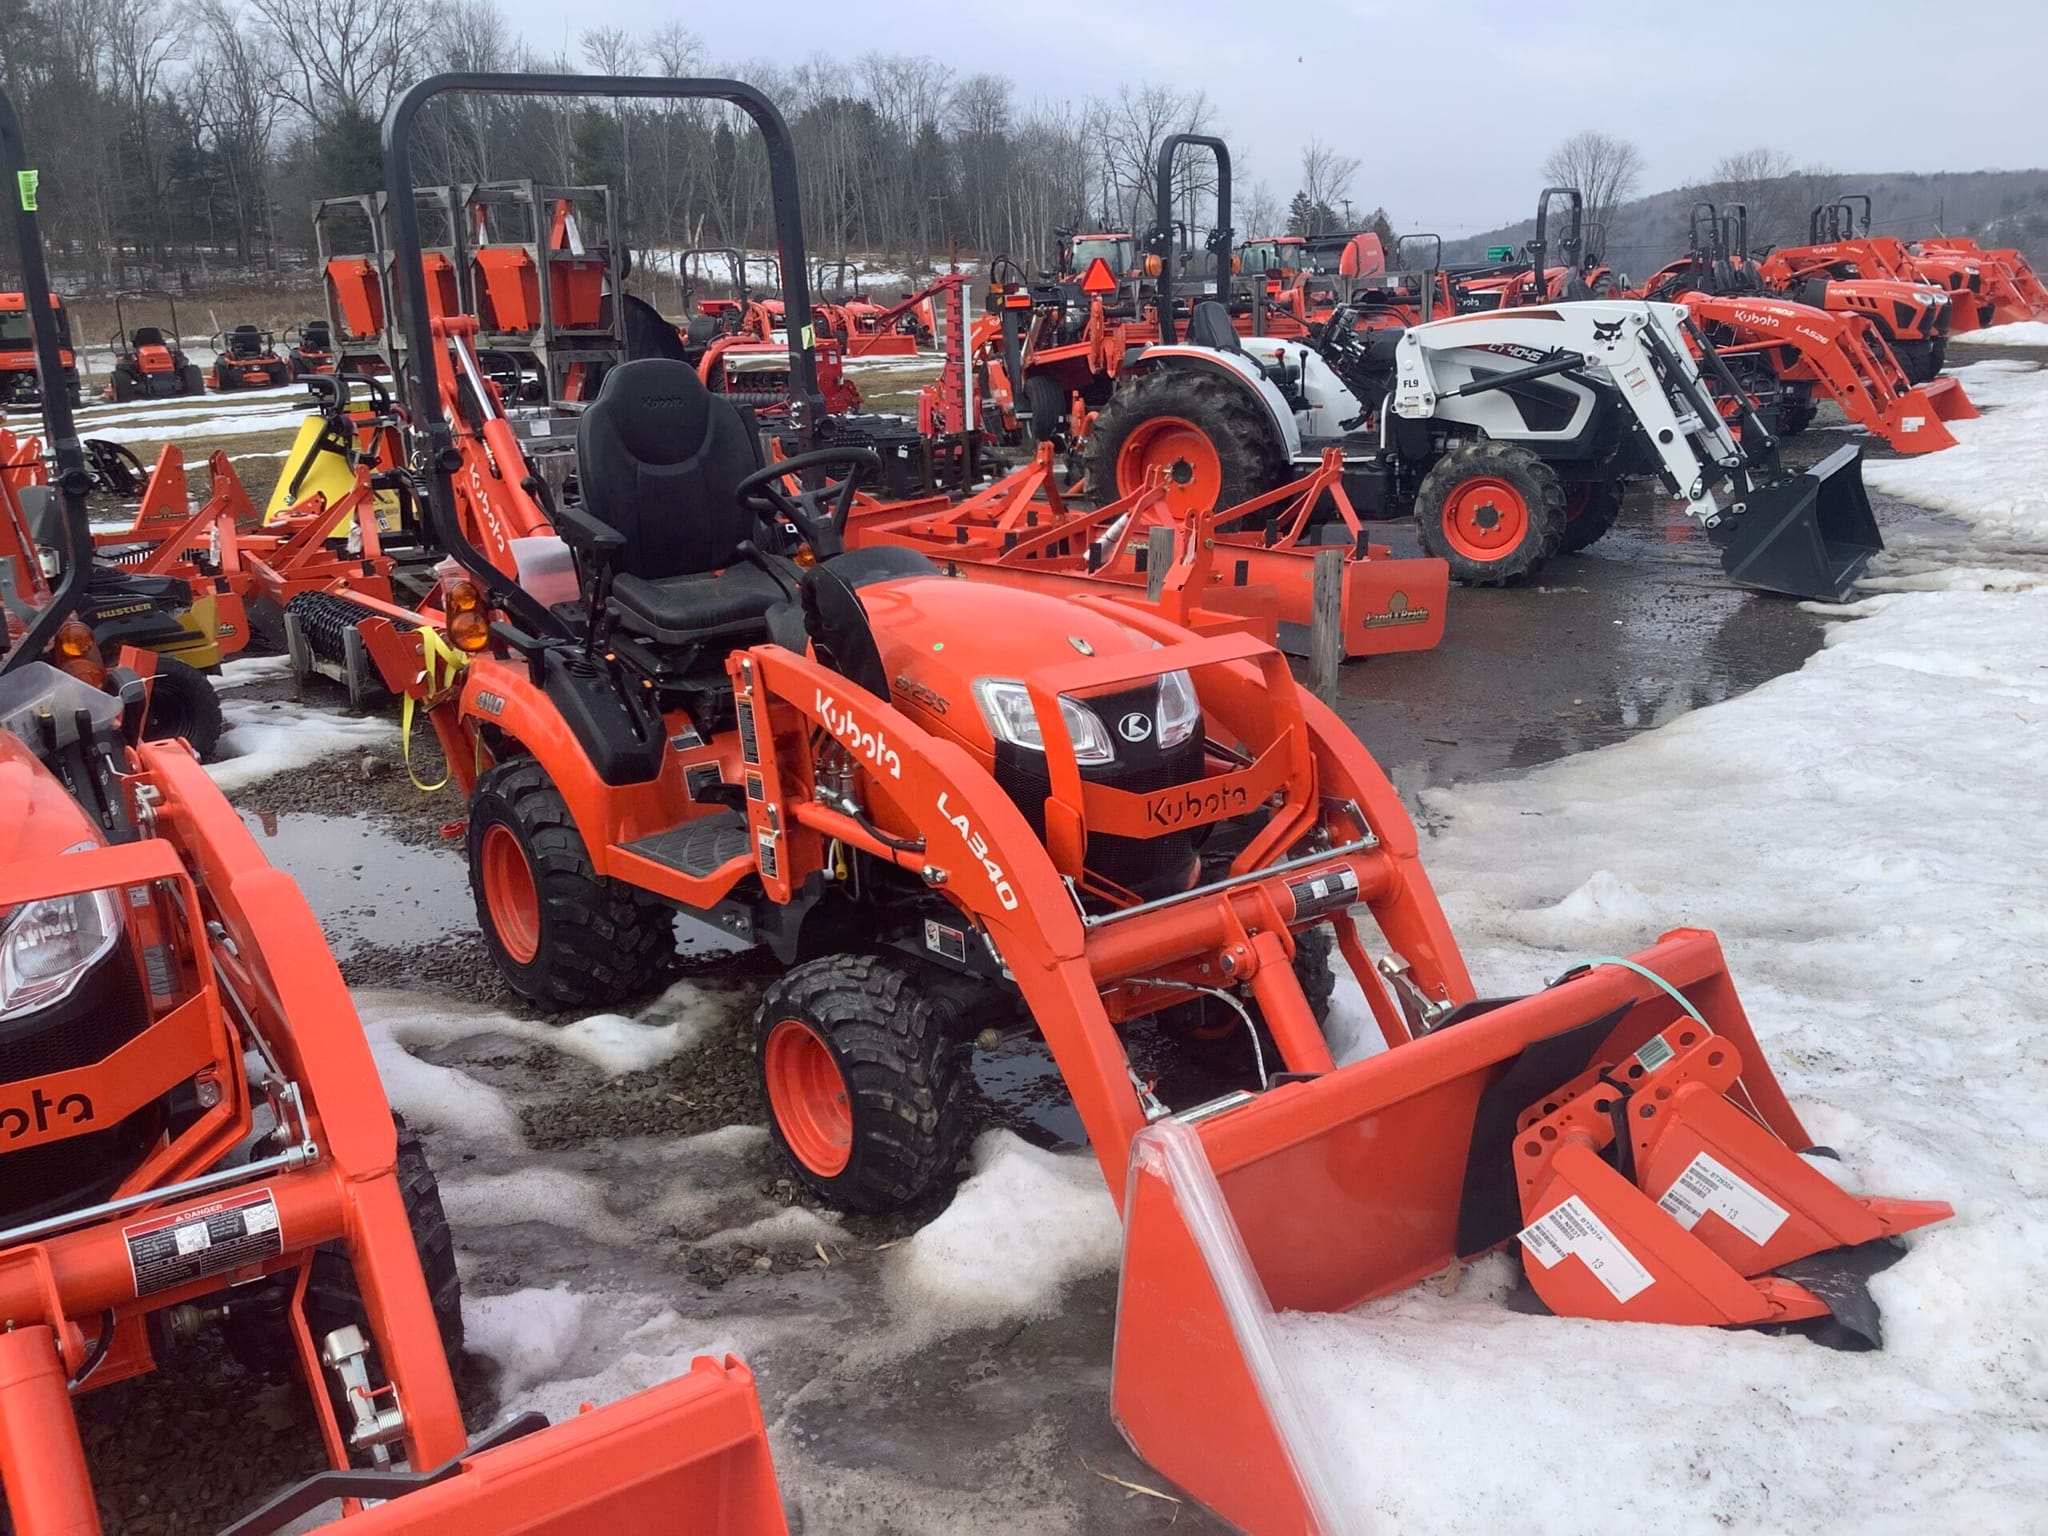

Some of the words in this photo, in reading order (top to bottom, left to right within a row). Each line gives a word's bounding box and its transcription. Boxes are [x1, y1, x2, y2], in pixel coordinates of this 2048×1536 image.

[1734, 309, 1780, 328] Kubota
[1403, 379, 1419, 388] FL9
[469, 462, 505, 552] Kubota
[97, 603, 152, 620] HUSTLER
[476, 690, 506, 716] 4WD
[815, 687, 901, 780] Kubota
[1146, 783, 1247, 826] Kubota
[936, 791, 1019, 912] LA340
[184, 1204, 224, 1220] DANGER
